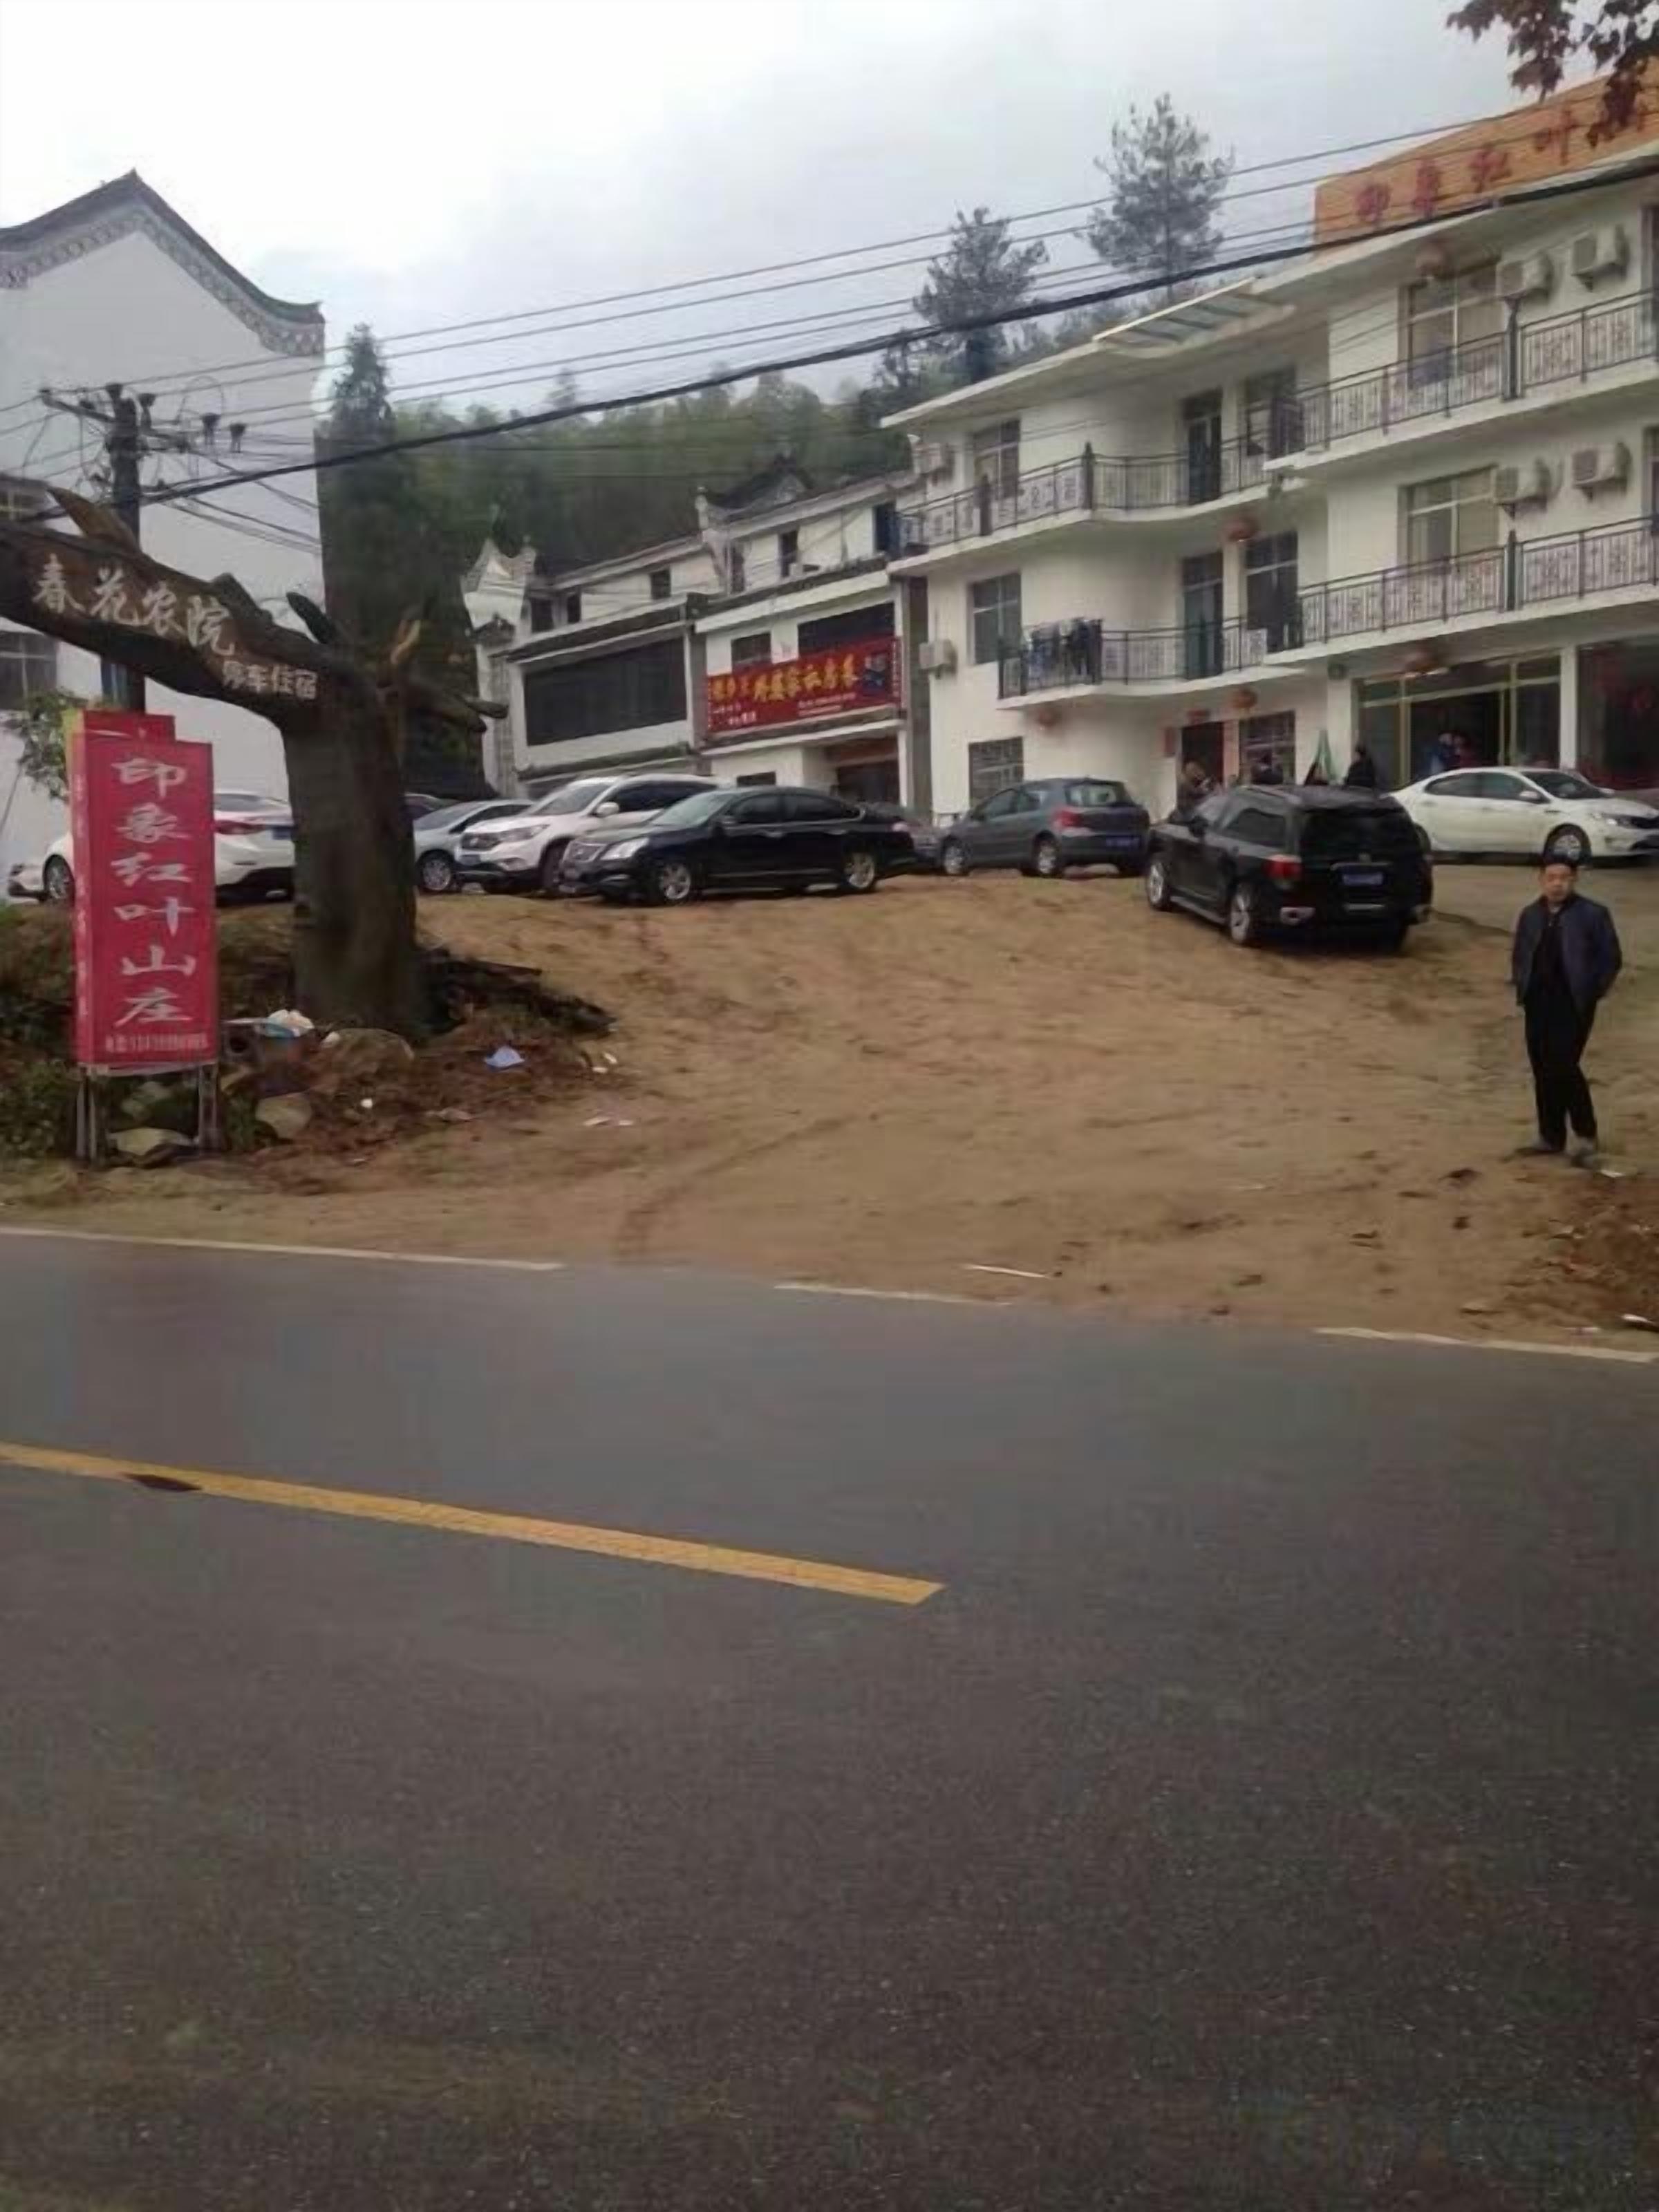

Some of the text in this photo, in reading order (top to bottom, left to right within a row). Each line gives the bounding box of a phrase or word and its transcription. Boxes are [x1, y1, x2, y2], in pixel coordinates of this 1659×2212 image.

[32, 553, 234, 655] 春花农院
[110, 756, 196, 1028] 印象红叶山庄
